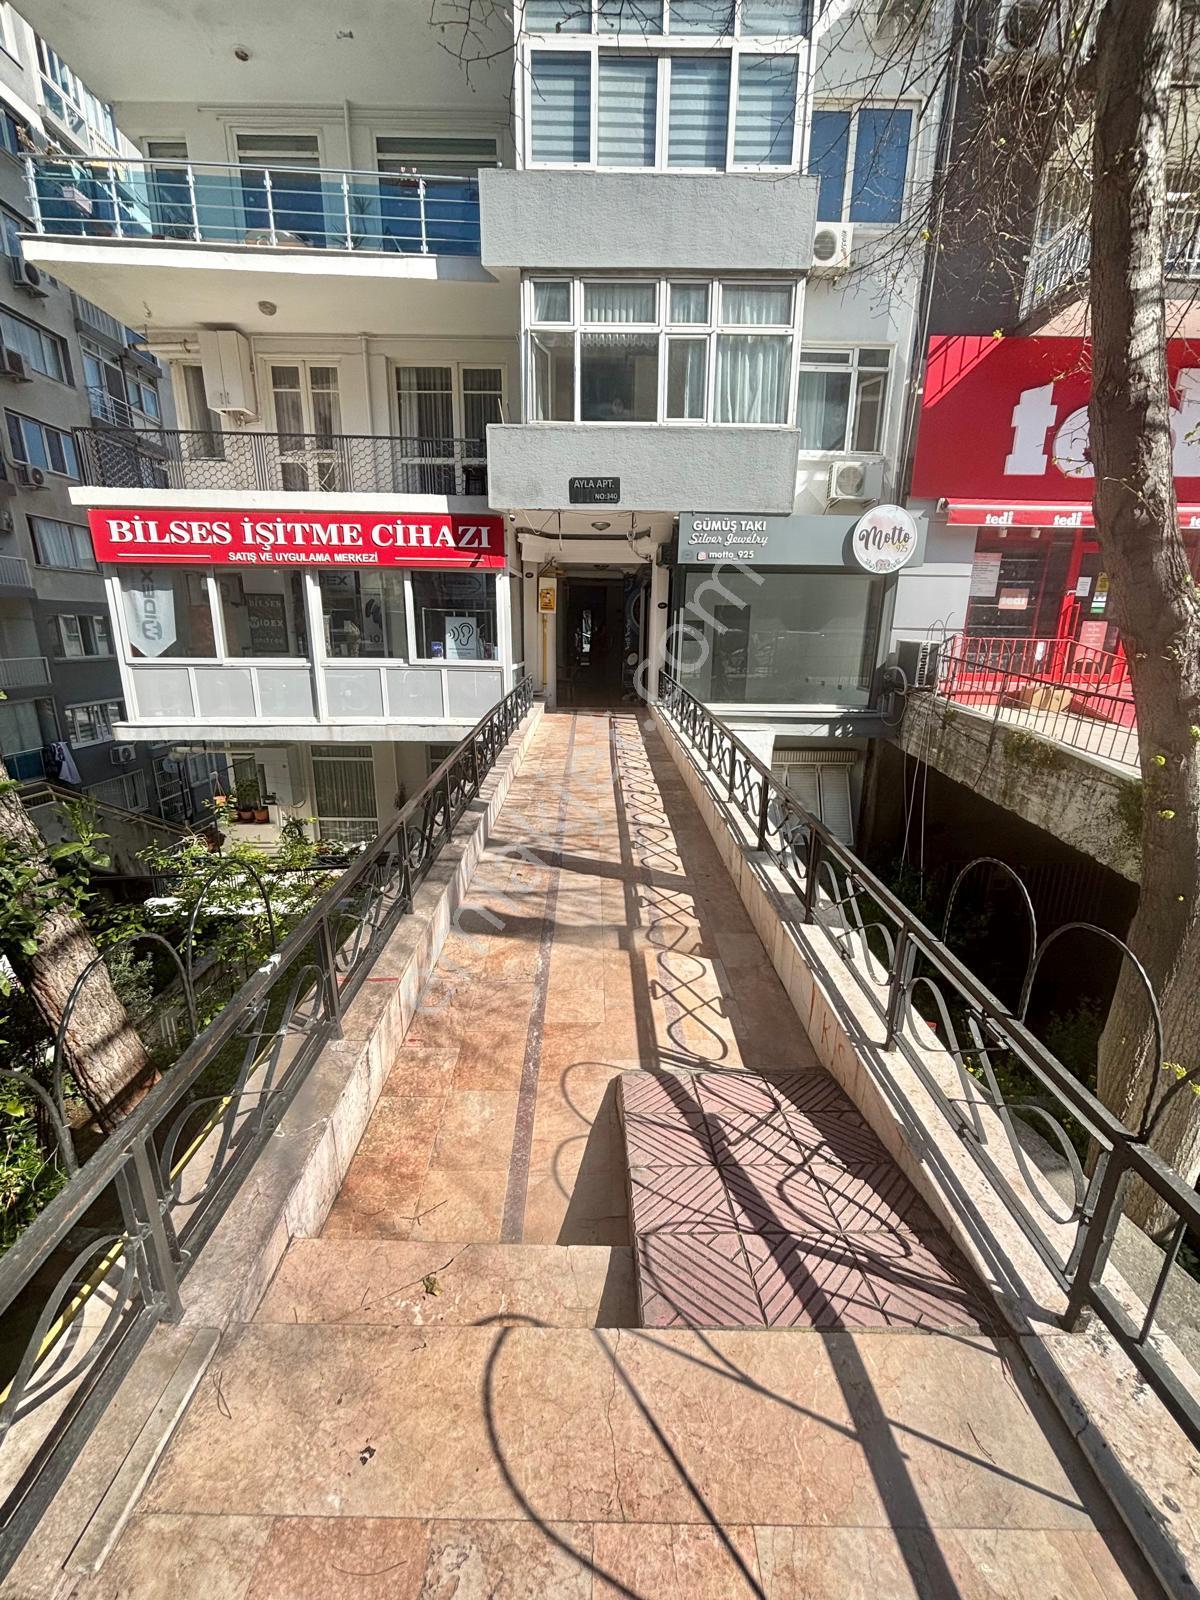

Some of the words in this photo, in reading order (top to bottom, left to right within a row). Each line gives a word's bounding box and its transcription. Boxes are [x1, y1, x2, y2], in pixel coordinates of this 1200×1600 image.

[574, 480, 595, 488] AYLA
[596, 480, 615, 488] APT.
[693, 517, 737, 533] GÜMÜŞ
[740, 520, 767, 531] TAKI
[985, 511, 1014, 525] tedi
[1053, 512, 1082, 526] tedi
[106, 516, 232, 545] BİLSES
[241, 517, 363, 550] İŞİTME
[371, 520, 492, 548] CİHAZI
[688, 533, 722, 545] Silver
[724, 531, 769, 546] Jewelry
[858, 525, 912, 551] Motto
[709, 550, 754, 561] motto_925
[896, 544, 908, 553] 925
[228, 552, 256, 563] SATIŞ
[259, 553, 273, 562] VE
[275, 553, 331, 563] UYGULAMA
[334, 552, 378, 563] MERKEZİ
